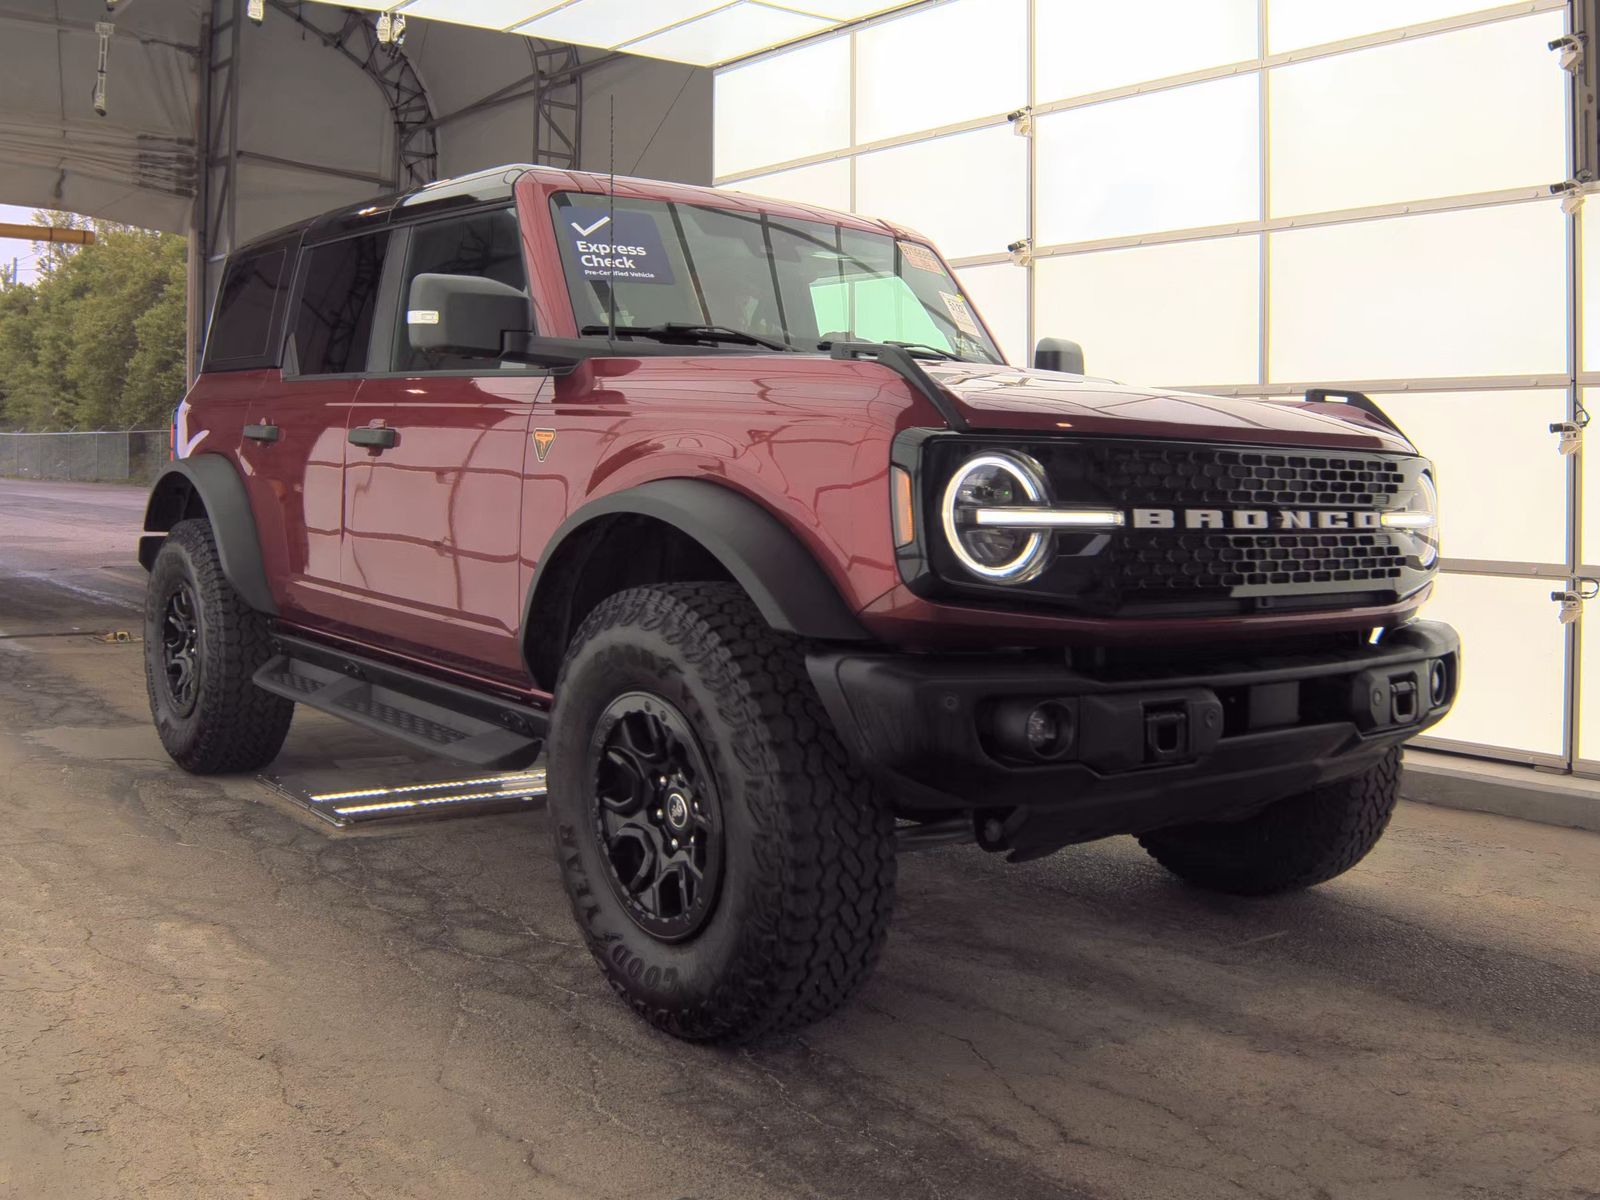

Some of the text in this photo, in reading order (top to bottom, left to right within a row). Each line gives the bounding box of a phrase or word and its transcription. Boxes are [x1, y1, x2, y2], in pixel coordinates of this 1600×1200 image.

[576, 240, 647, 256] Express
[581, 254, 636, 269] Check
[584, 269, 629, 277] Pre-Cerified
[1133, 508, 1381, 529] BRONCO
